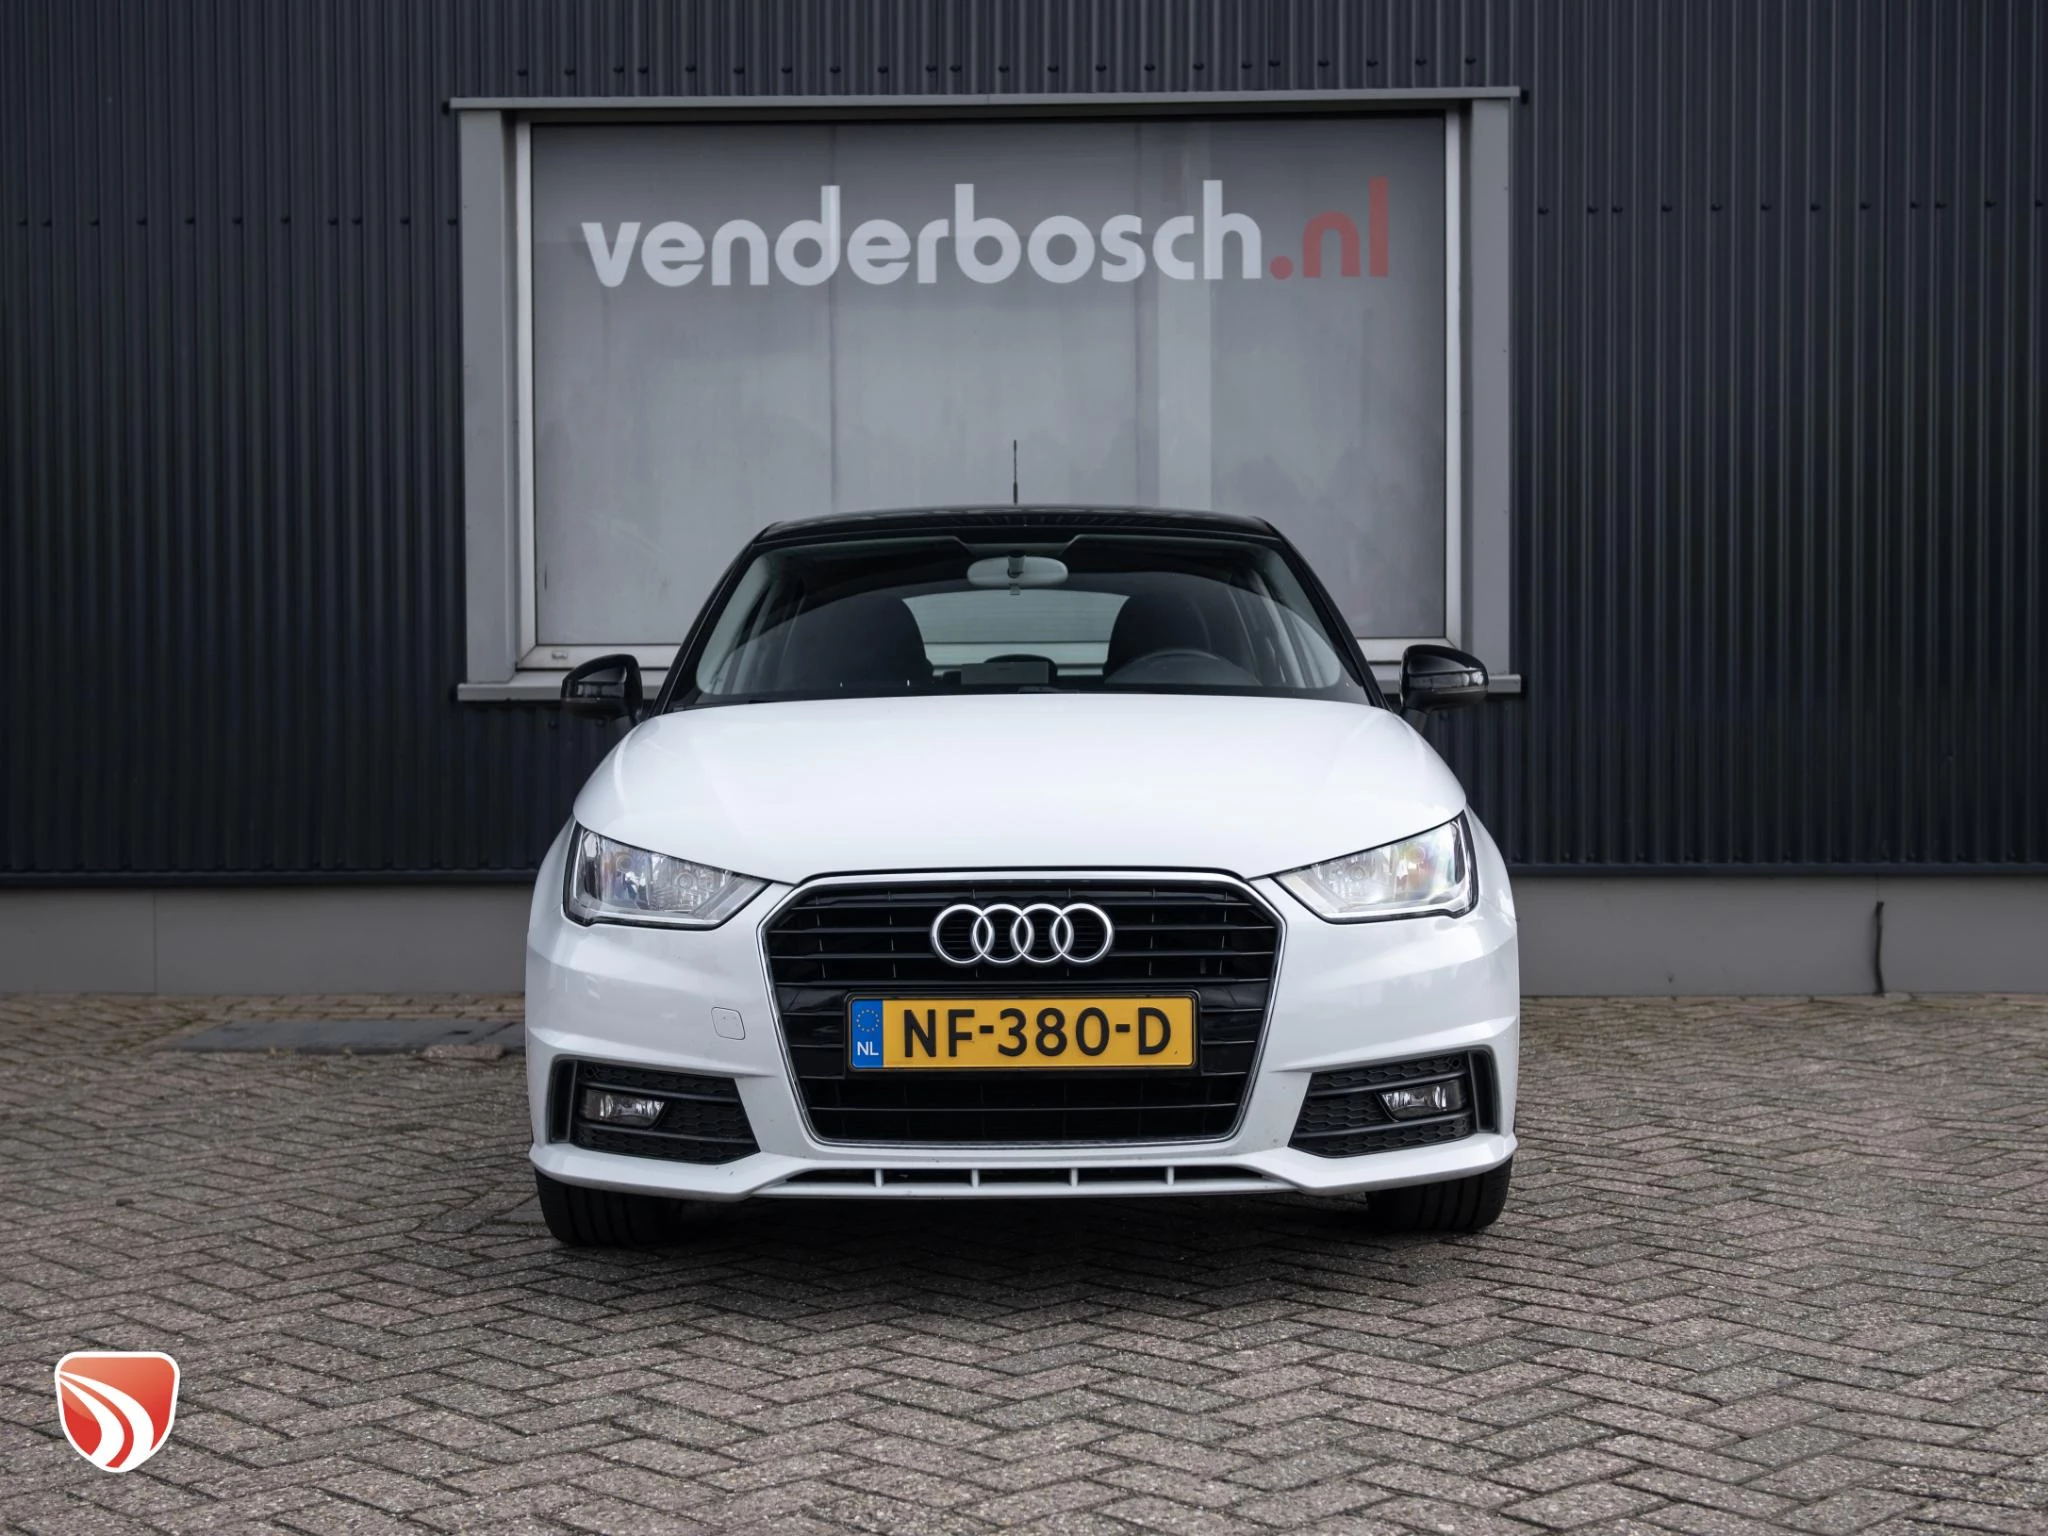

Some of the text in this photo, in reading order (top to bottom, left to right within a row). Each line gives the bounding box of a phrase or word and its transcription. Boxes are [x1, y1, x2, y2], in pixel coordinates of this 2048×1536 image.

[581, 178, 1389, 287] venderbosch.nl
[857, 1007, 1172, 1058] NL NF-380-D
